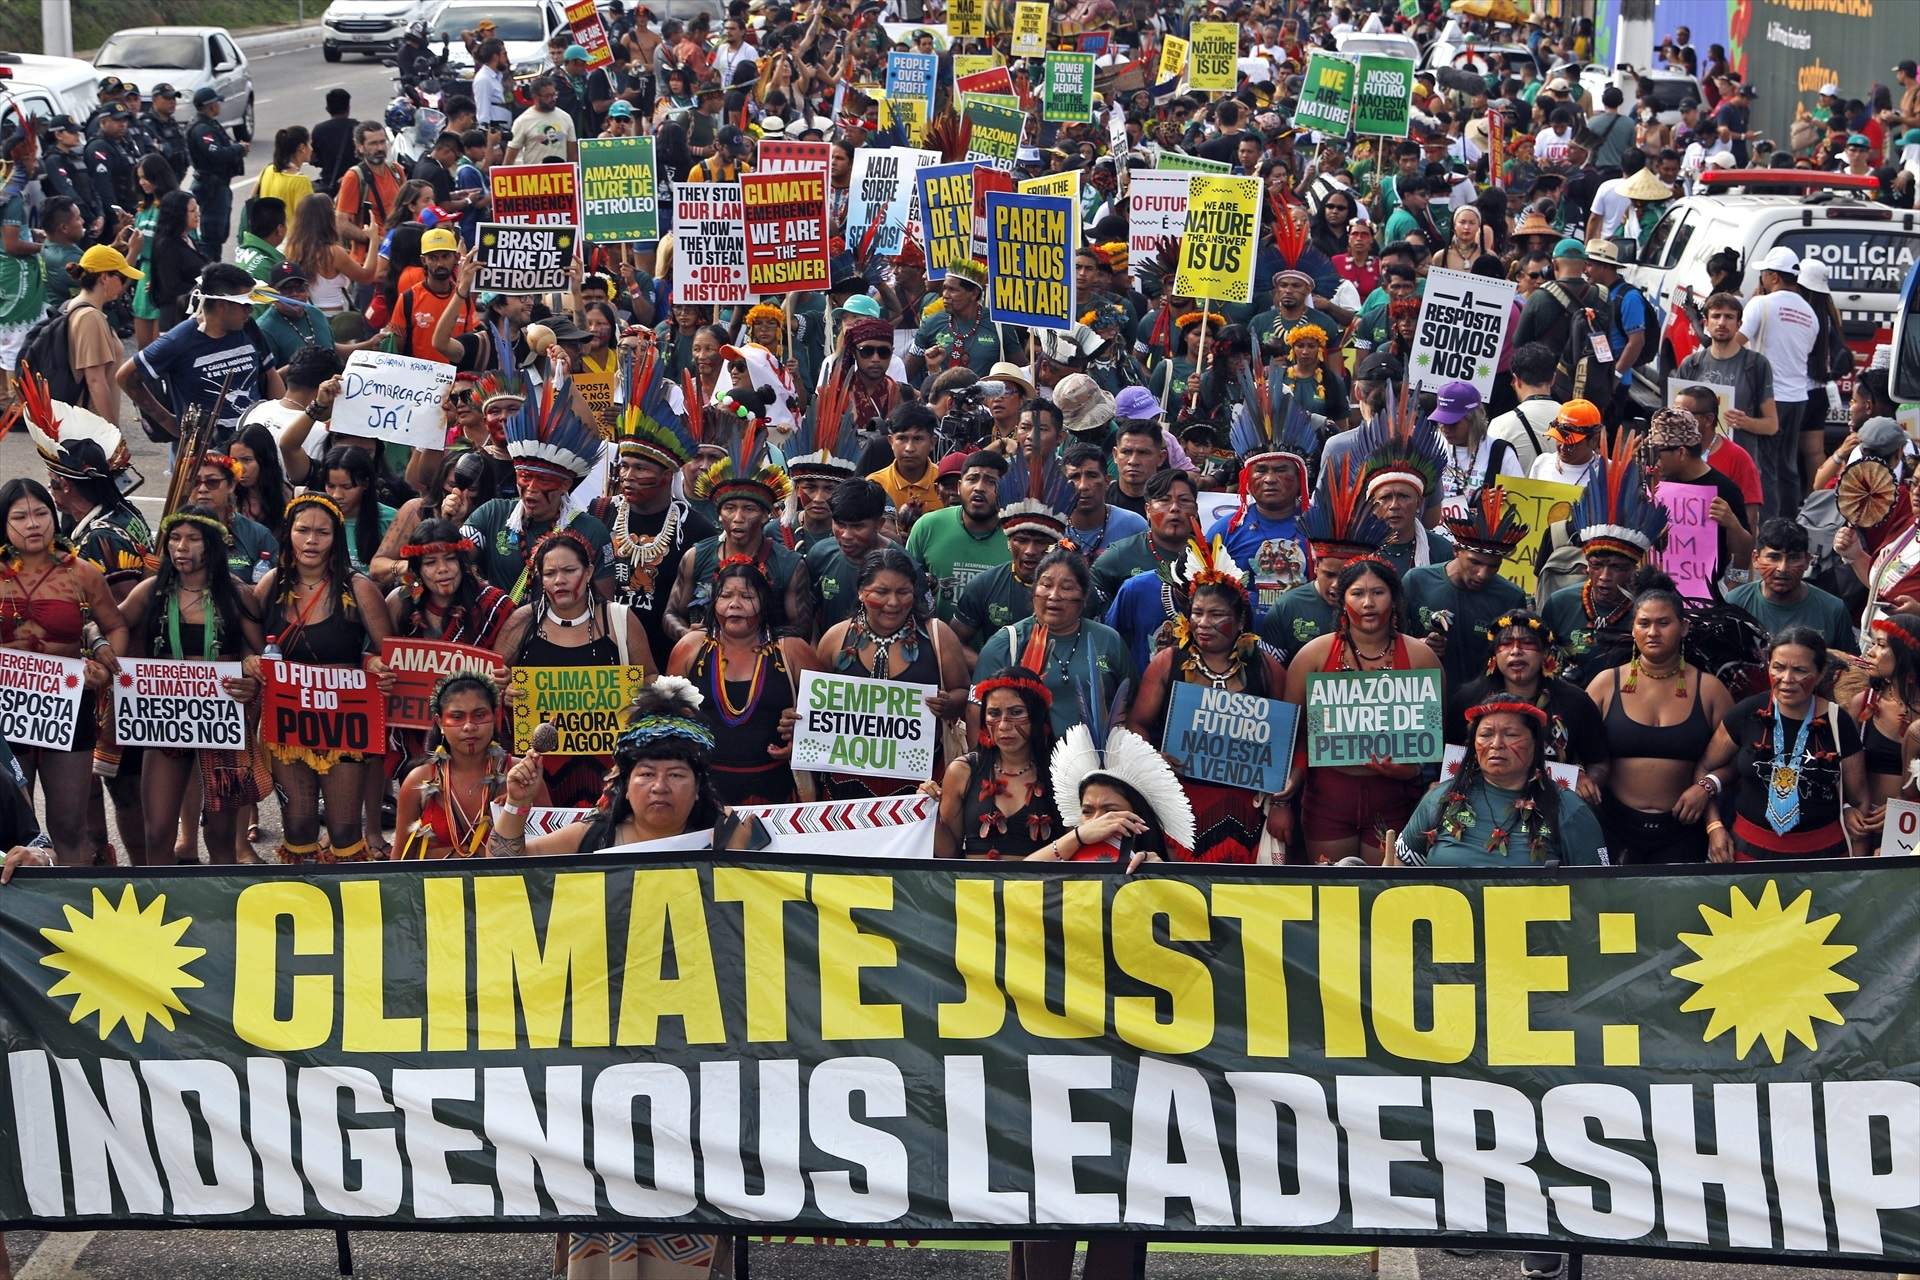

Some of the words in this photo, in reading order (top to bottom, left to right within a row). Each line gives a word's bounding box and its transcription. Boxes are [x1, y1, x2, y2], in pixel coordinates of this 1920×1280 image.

[1192, 41, 1236, 55] NATURE
[894, 57, 930, 71] PEOPLE
[898, 69, 924, 81] OVER
[1054, 62, 1084, 73] POWER
[1197, 60, 1210, 74] IS
[1212, 59, 1230, 75] US
[893, 80, 928, 94] PROFIT
[1055, 73, 1065, 83] TO
[1067, 73, 1083, 83] THE
[1319, 67, 1347, 91] WE
[1367, 70, 1404, 83] NOSSO
[1053, 83, 1083, 94] PEOPLE
[1315, 87, 1342, 106] ARE
[1363, 82, 1406, 98] FUTURO
[1298, 100, 1349, 124] NATURE
[1372, 107, 1404, 122] VENDA
[971, 124, 1017, 146] MAZÔNIA
[1000, 142, 1016, 160] DE
[585, 164, 651, 181] AMAZÔNIA
[866, 156, 898, 179] NADA
[494, 173, 573, 198] CLIMATE
[584, 180, 628, 200] LIVRE
[631, 179, 653, 198] DE
[678, 187, 710, 201] THEY
[744, 180, 823, 205] CLIMATE
[861, 179, 899, 202] SOBRE
[926, 174, 973, 208] PARE
[1053, 180, 1069, 195] THE
[495, 195, 573, 213] EMERGENCY
[585, 196, 654, 216] PETRÓLEO
[678, 203, 710, 220] OUR
[713, 203, 742, 220] LAN
[746, 202, 822, 221] EMERGENCY
[1132, 195, 1143, 212] O
[1146, 196, 1187, 213] FUTUR
[1204, 201, 1217, 210] WE
[1218, 202, 1239, 211] ARE
[701, 221, 730, 235] NOW
[750, 222, 781, 245] WE
[785, 219, 821, 241] ARE
[930, 207, 956, 239] DE
[995, 205, 1066, 245] PAREM
[1162, 215, 1169, 229] É
[1184, 209, 1254, 237] NATURE
[497, 231, 557, 251] BRASIL
[680, 237, 713, 251] THEY
[714, 237, 744, 251] WAN
[1187, 233, 1204, 242] THE
[1205, 235, 1247, 247] ANSWER
[487, 250, 537, 270] LIVRE
[539, 251, 562, 269] DE
[687, 251, 703, 265] TO
[706, 251, 745, 265] STEAL
[775, 245, 797, 259] THE
[997, 242, 1022, 277] DE
[1025, 246, 1065, 282] NOS
[1187, 242, 1208, 270] IS
[1209, 244, 1241, 274] US
[1805, 241, 1914, 265] POLÍCIA
[701, 267, 731, 283] OUR
[751, 259, 826, 285] ANSWER
[683, 284, 747, 301] HISTORY
[995, 276, 1069, 319] MATAR!
[1461, 290, 1474, 309] A
[1424, 302, 1502, 334] RESPOSTA
[1420, 322, 1499, 359] SOMOS
[1430, 350, 1477, 381] NÓS
[135, 663, 217, 681] EMERGÊNCIA
[389, 647, 495, 677] AMAZÔNIA
[0, 668, 60, 694] IMÁTICA
[136, 675, 219, 698] CLIMÁTICA
[274, 661, 288, 684] O
[290, 663, 367, 690] FUTURO
[535, 671, 591, 691] CLIMA
[595, 670, 621, 690] DE
[301, 687, 312, 708] É
[313, 690, 338, 710] DO
[536, 687, 622, 713] AMBIÇÃO
[809, 678, 922, 717] SEMPRE
[1310, 674, 1438, 706] AMAZÔNIA
[0, 688, 73, 722] SPOSTA
[118, 697, 133, 718] A
[137, 698, 240, 722] RESPOSTA
[1200, 688, 1270, 720] NOSSO
[276, 706, 369, 750] POVO
[554, 712, 619, 732] AGORA
[808, 711, 922, 741] ESTIVEMOS
[1192, 709, 1271, 744] FUTURO
[1323, 705, 1391, 733] LIVRE
[1393, 705, 1425, 730] DE
[30, 716, 72, 746] NÓS
[118, 718, 193, 743] SOMOS
[199, 718, 242, 745] NÓS
[828, 735, 897, 769] AQUI
[1181, 730, 1224, 759] NÃO
[1227, 738, 1273, 768] ESTÁ
[1315, 729, 1436, 760] PETRÓLEO
[1201, 758, 1265, 789] VENDA
[1899, 811, 1917, 834] O
[231, 868, 905, 1053] CLIMATE
[937, 877, 1641, 1067] JUSTICE:
[7, 1049, 910, 1224] INDIGENOUS
[943, 1053, 1920, 1256] LEADERSHIP
